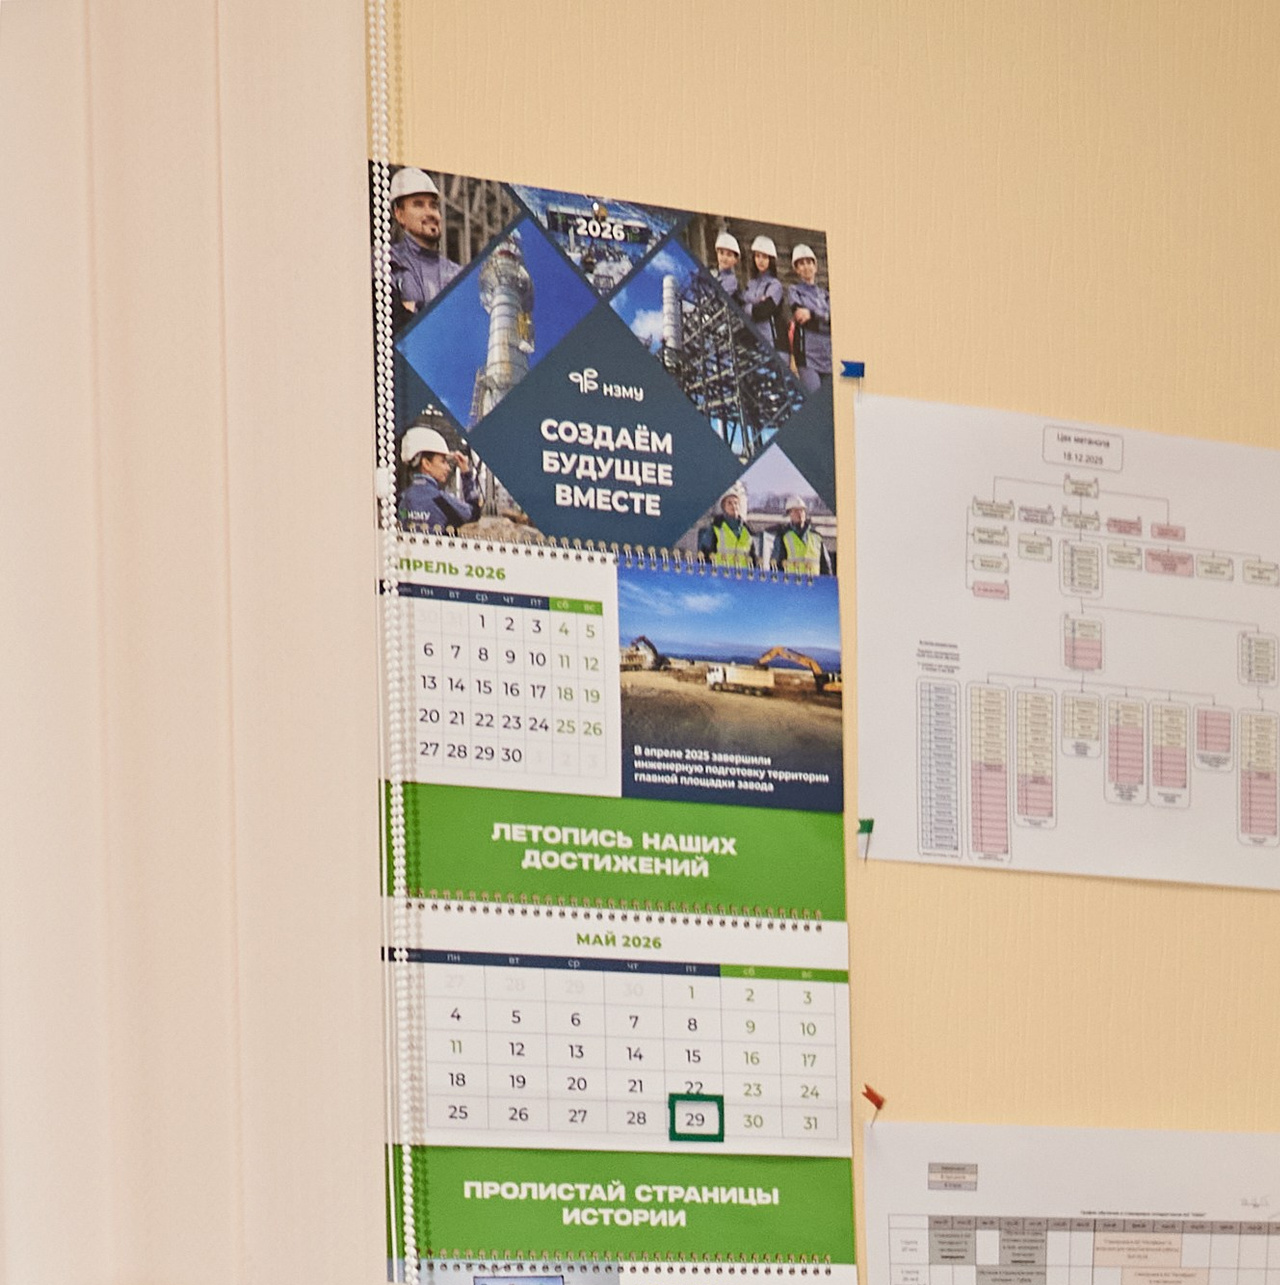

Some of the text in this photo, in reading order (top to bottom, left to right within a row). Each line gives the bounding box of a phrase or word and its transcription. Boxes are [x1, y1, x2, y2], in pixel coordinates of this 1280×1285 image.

[577, 218, 626, 240] 2026
[541, 419, 672, 455] СОЗДАЁМ
[543, 450, 673, 487] БУДУЩЕЕ
[556, 482, 662, 516] ВМЕСТЕ
[396, 557, 505, 580] ПРЕЛЬ 2026
[420, 588, 434, 597] пн
[449, 590, 460, 599] вт
[475, 593, 488, 603] ср
[503, 595, 514, 605] чт
[530, 598, 541, 607] пт
[556, 599, 569, 610] сб
[480, 615, 595, 638] 1 2 3 4 5
[424, 643, 598, 671] 6 7 8 9 10 11 12
[422, 675, 600, 703] 13 14 15 16 17 18 19
[420, 709, 602, 736] 20 21 22 23 24 25 26
[420, 742, 522, 762] 27 28 29 30
[634, 745, 771, 766] В апреле 2025 завершили
[634, 759, 829, 784] инженерную подготовку территории
[634, 773, 774, 792] главной площадки завода
[492, 823, 736, 854] ЛЕТОПИСЬ НАШИХ
[522, 848, 710, 877] ДОСТИЖЕНИЙ
[577, 934, 661, 948] МАЙ 2026
[446, 953, 461, 963] пн
[508, 956, 520, 966] вт
[567, 957, 581, 969] ср
[626, 961, 639, 971] чт
[685, 964, 697, 974] пт
[689, 986, 694, 999] 1
[746, 988, 754, 1002] 2
[804, 991, 812, 1004] 3
[451, 1008, 816, 1036] 4 5 6 7 8 9 10
[451, 1040, 816, 1067] 11 12 13 14 15 16 17
[450, 1073, 819, 1098] 18 19 20 21 22 23 24
[449, 1106, 817, 1129] 25 26 27 28 29 30 31
[464, 1181, 779, 1205] ПРОЛИСТАЙ СТРАНИЦЫ
[563, 1208, 686, 1226] ИСТОРИИ
